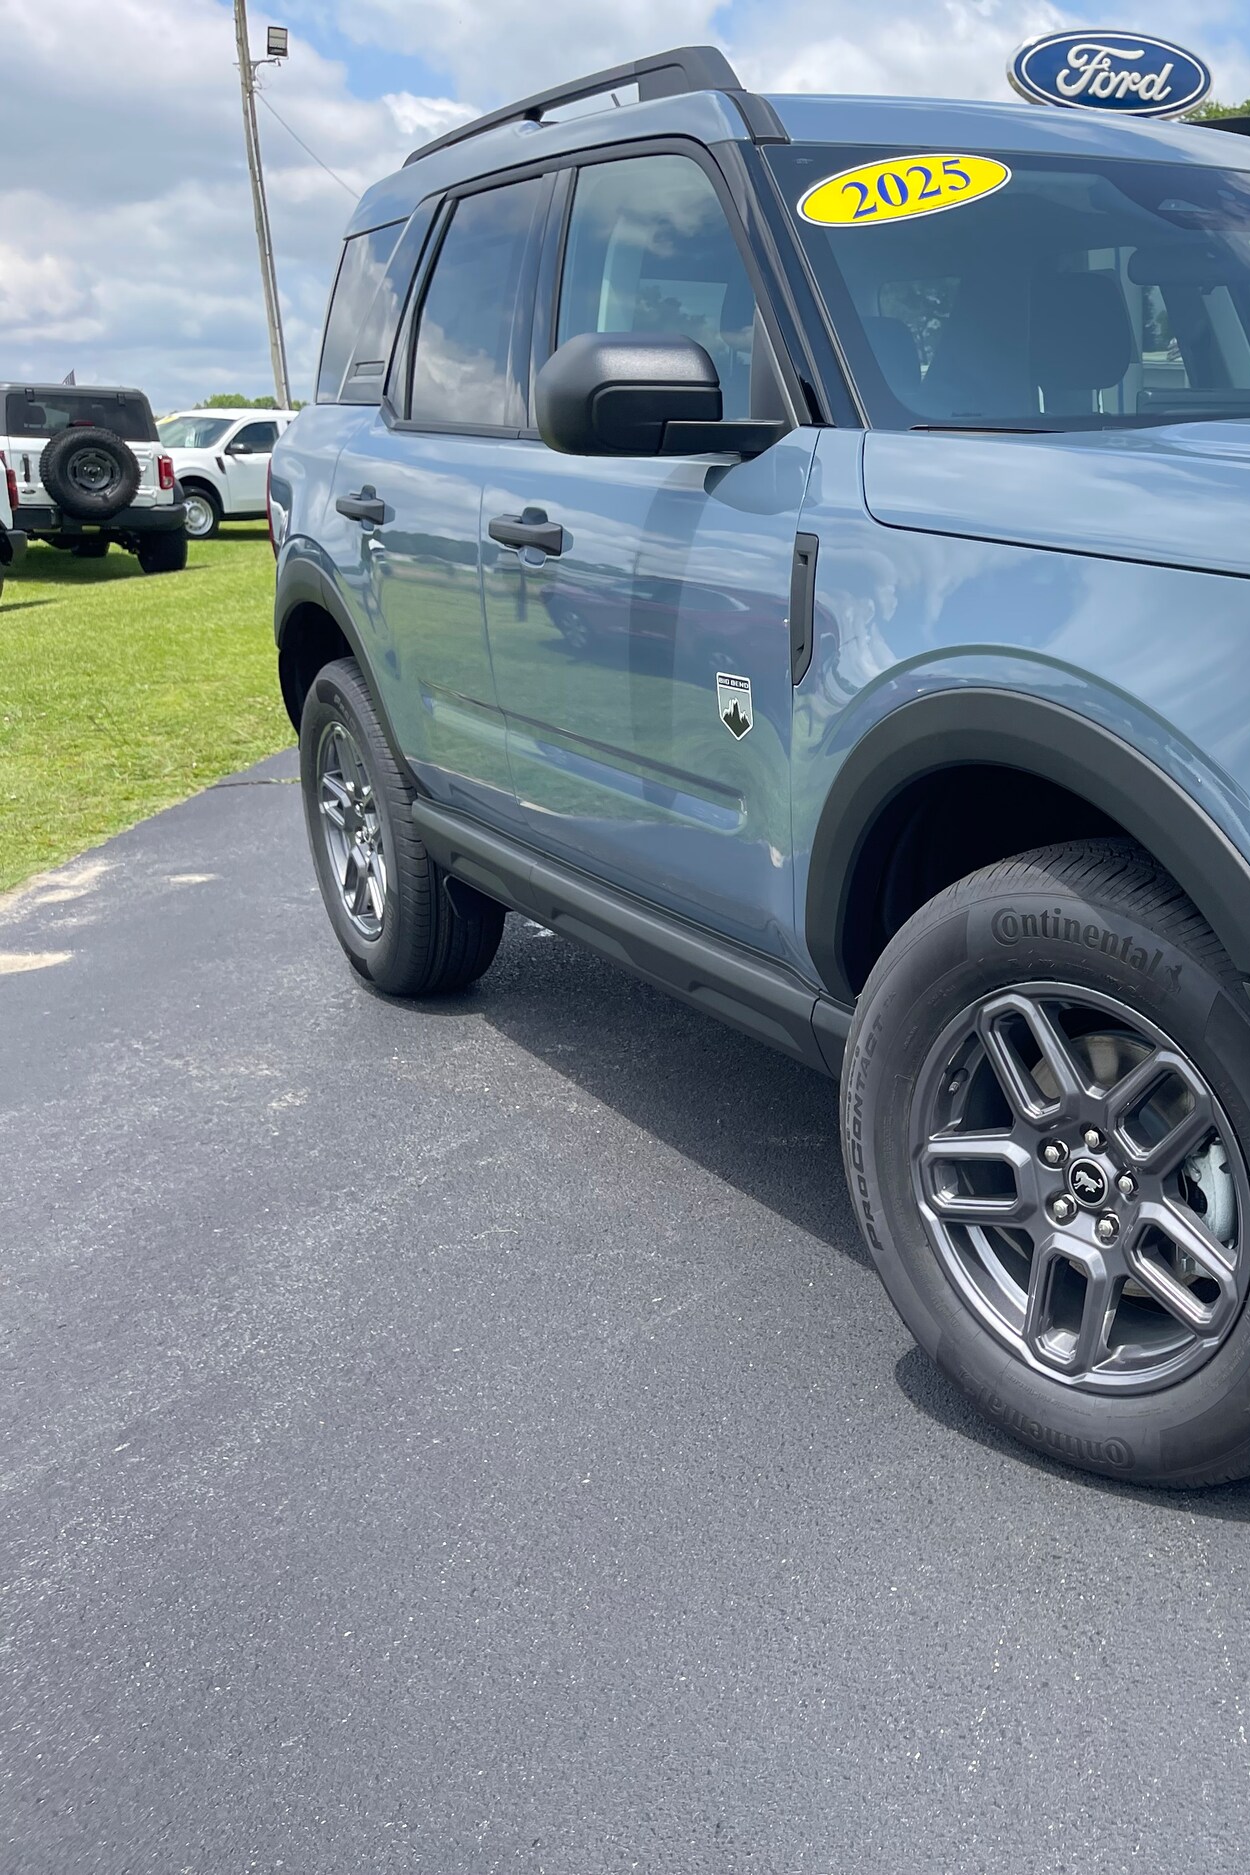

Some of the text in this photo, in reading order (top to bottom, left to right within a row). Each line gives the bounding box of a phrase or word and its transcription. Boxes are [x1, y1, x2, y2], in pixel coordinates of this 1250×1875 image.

[1056, 43, 1174, 101] Ford
[841, 159, 971, 219] 2025
[990, 906, 1164, 980] Continental
